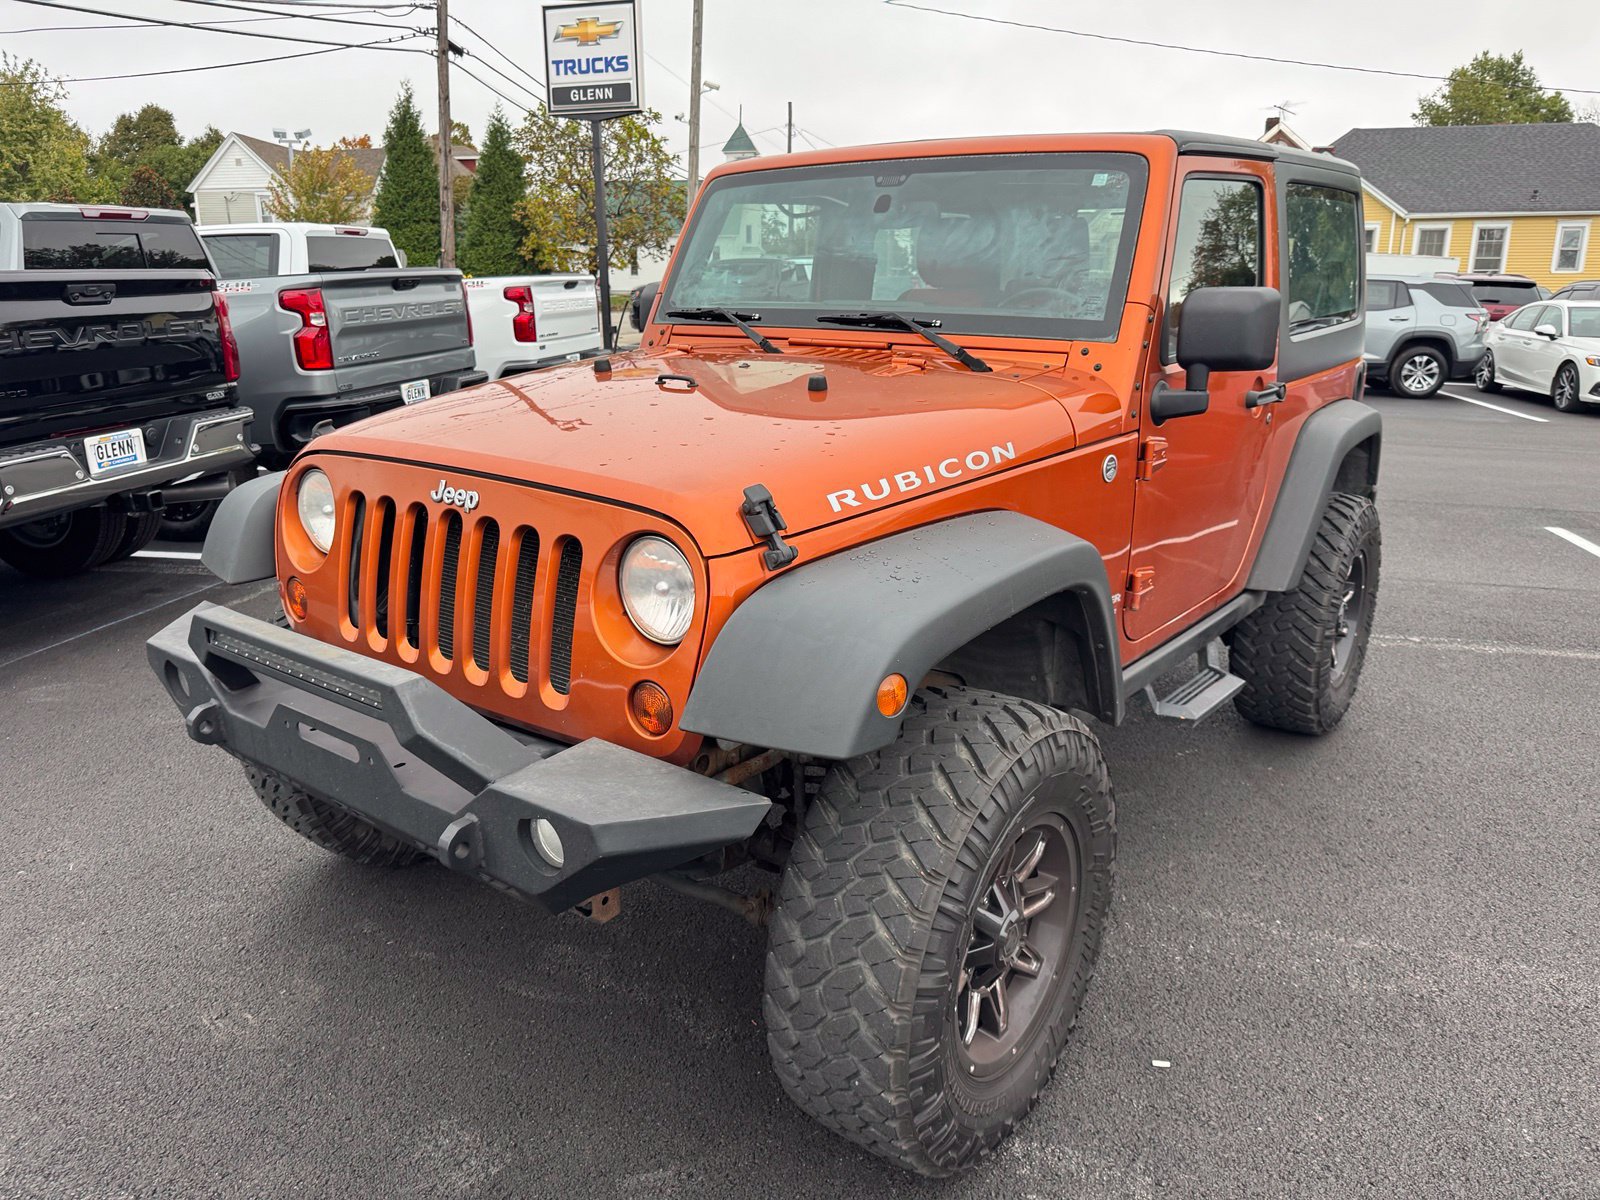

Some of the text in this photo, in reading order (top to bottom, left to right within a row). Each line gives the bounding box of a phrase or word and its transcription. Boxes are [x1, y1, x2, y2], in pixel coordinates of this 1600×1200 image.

[551, 55, 629, 76] TRUCKS
[570, 87, 613, 102] GLENN
[343, 301, 464, 325] CHEVROLET
[407, 386, 426, 400] GLENN
[96, 438, 134, 460] GLENN
[826, 441, 1016, 513] RUBICON
[430, 479, 480, 514] Jeep
